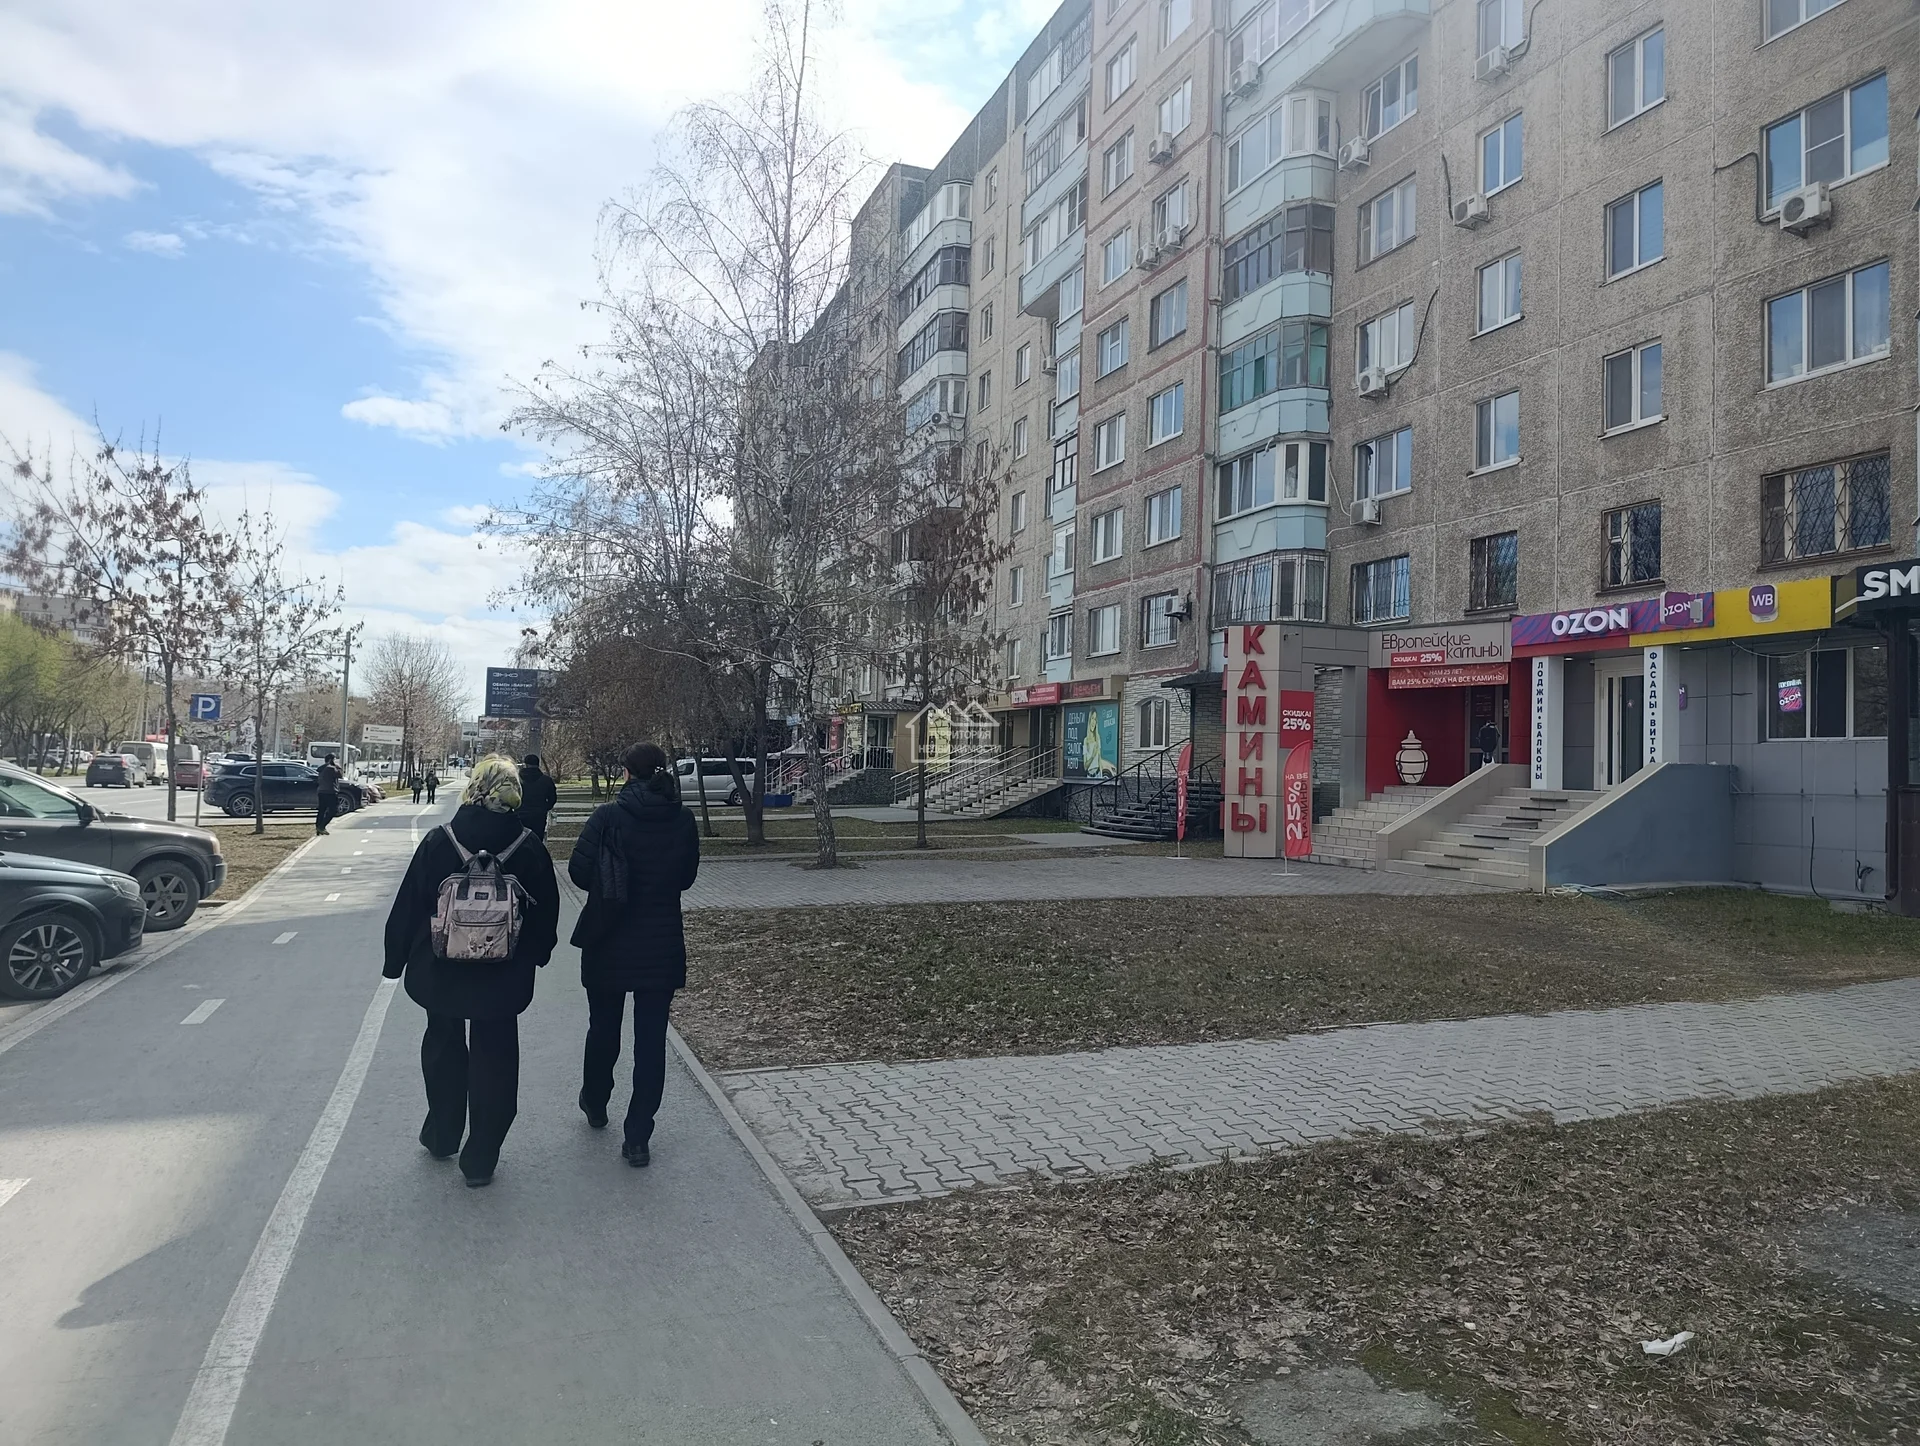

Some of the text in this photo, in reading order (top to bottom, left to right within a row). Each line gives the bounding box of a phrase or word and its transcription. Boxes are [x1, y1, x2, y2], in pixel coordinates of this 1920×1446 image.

[1751, 593, 1774, 607] WB
[1551, 608, 1630, 637] OZON
[1393, 653, 1442, 663] СКИДКА! 25%
[1422, 677, 1447, 685] СКИДКА
[1471, 674, 1505, 682] КАМИНЫ
[1649, 652, 1657, 709] ФАСАДЫ
[1536, 661, 1544, 713] ЛОДЖИИ
[1779, 692, 1801, 706] OZON
[197, 697, 216, 719] P
[1282, 709, 1312, 718] СКИДКА!
[1067, 712, 1085, 725] ДЕНЬГИ
[1282, 717, 1311, 731] 25%
[1067, 727, 1078, 740] ПОД
[1231, 625, 1268, 834] КАМИНЫ
[1067, 742, 1082, 755] ЗАЛОГ
[1535, 722, 1543, 780] БАЛКОНЫ
[1067, 757, 1079, 770] АВТО
[1286, 781, 1303, 841] 25%
